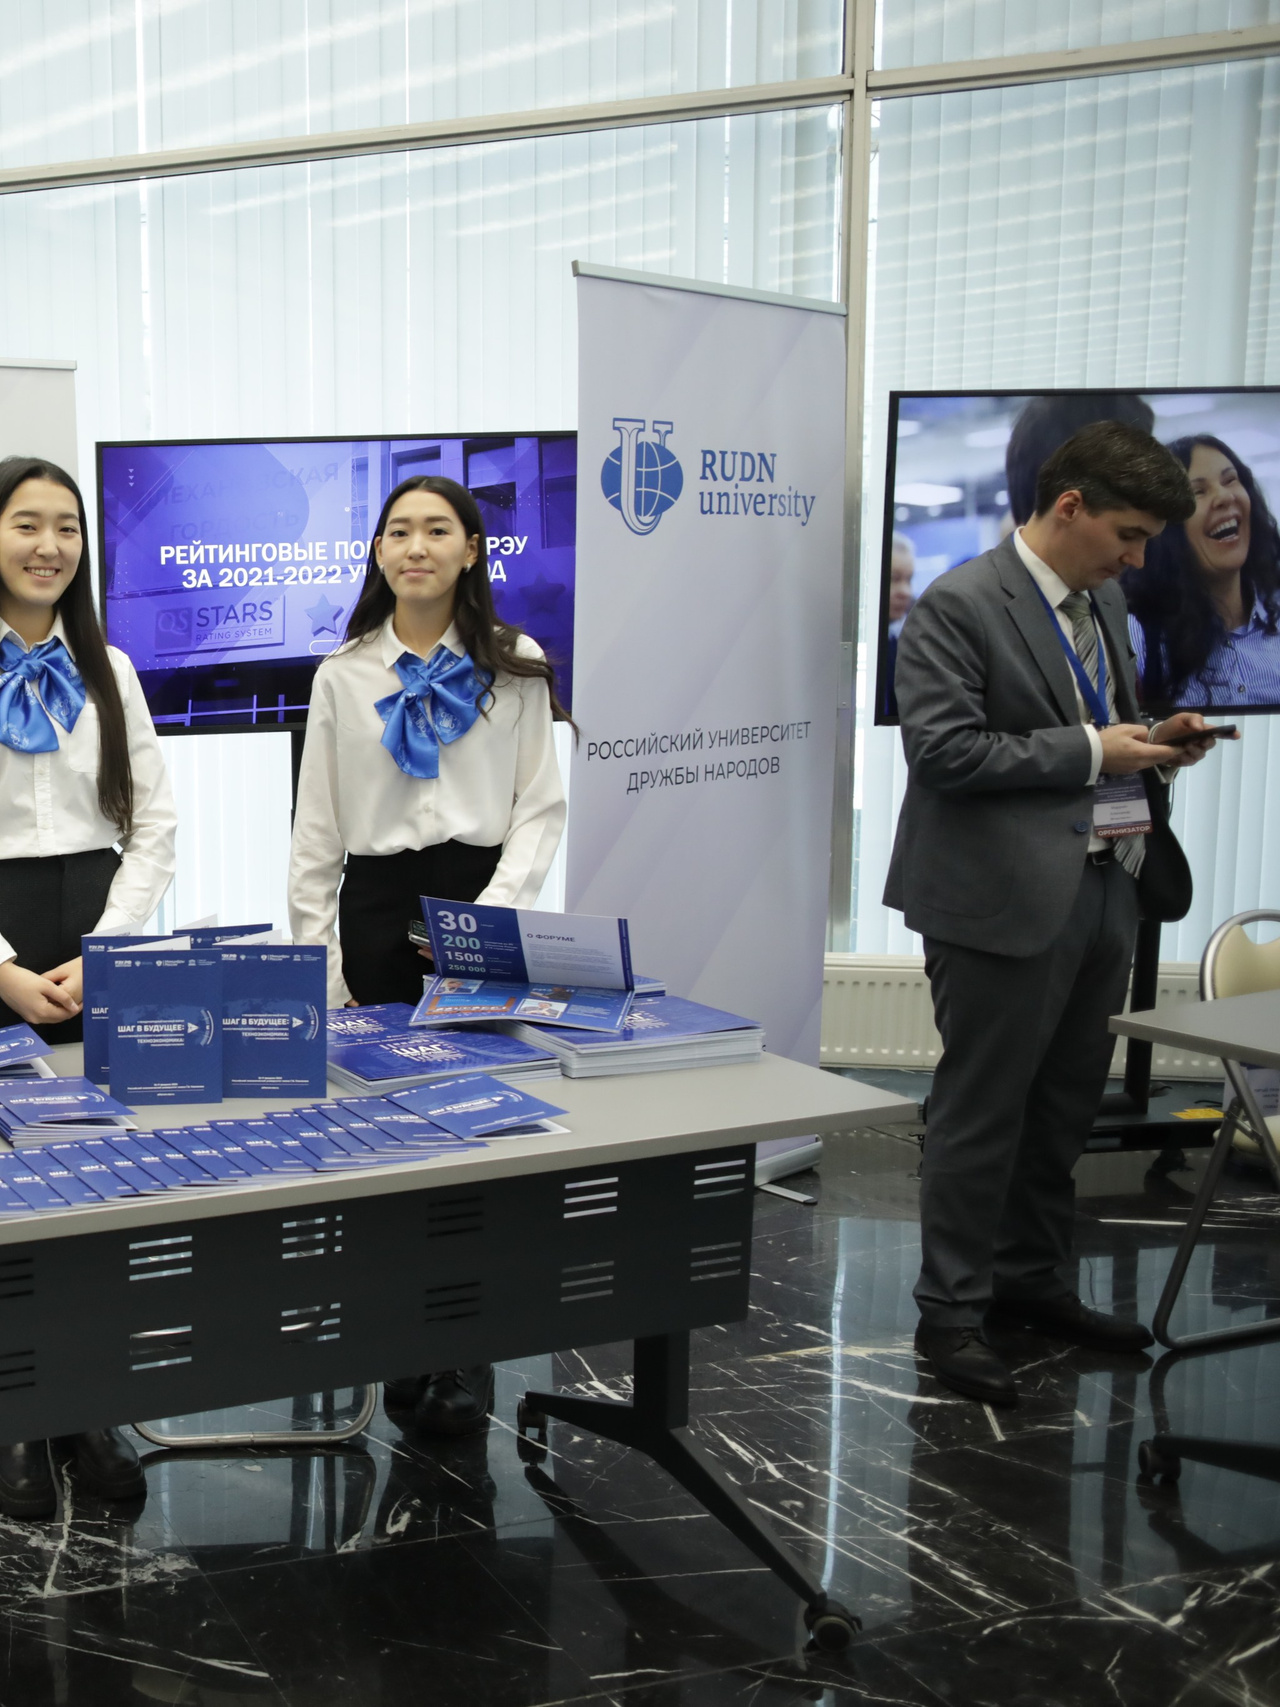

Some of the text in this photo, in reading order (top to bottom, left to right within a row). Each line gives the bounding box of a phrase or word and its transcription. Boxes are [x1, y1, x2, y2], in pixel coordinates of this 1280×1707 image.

[700, 449, 777, 483] RUDN
[699, 483, 815, 527] university
[160, 536, 528, 565] РЕЙТИНГОВЫЕ ПО РЭУ
[182, 567, 214, 589] ЗА
[219, 564, 341, 588] 2021-2022
[487, 560, 507, 582] Д
[158, 601, 273, 635] QS STARS
[196, 628, 272, 642] RATING SYSTEM
[587, 721, 811, 761] РОССИЙСКИЙ УНИВЕРСИТЕТ
[627, 756, 780, 795] ДРУЖБЫ НАРОДОВ
[1098, 825, 1151, 836] ОРГАНИЗАТОР
[437, 910, 477, 933] 30
[441, 934, 481, 950] 200
[535, 934, 575, 942] ФОРУМЕ
[445, 951, 484, 963] 1500
[448, 964, 466, 972] 250
[144, 1024, 185, 1032] БУДУЩЕЕ:
[248, 1018, 289, 1026] БУДУЩЕЕ:
